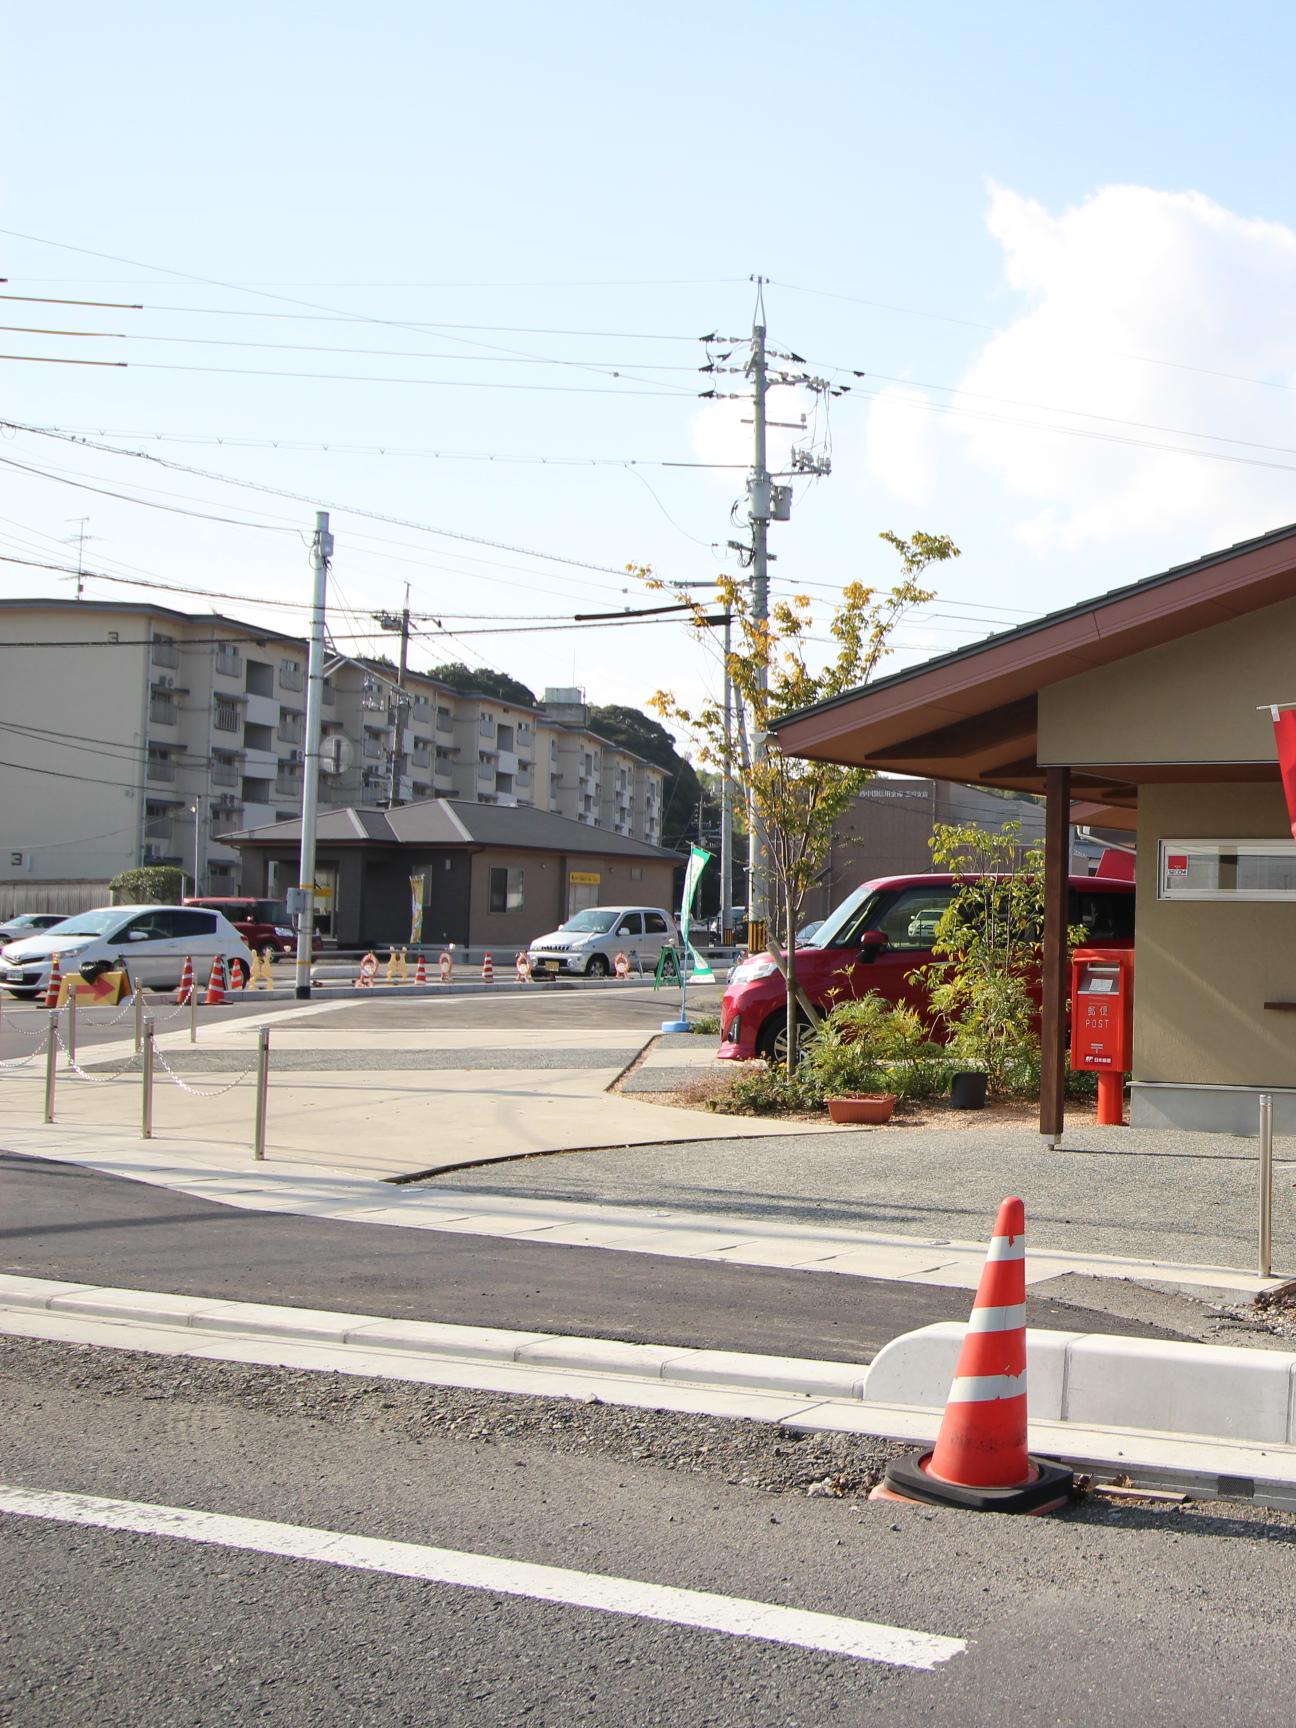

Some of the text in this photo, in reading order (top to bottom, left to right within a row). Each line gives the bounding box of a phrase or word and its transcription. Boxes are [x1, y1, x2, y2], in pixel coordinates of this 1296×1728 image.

[11, 852, 23, 866] 3
[1087, 1005, 1108, 1016] 郵便
[1085, 1019, 1110, 1029] POST
